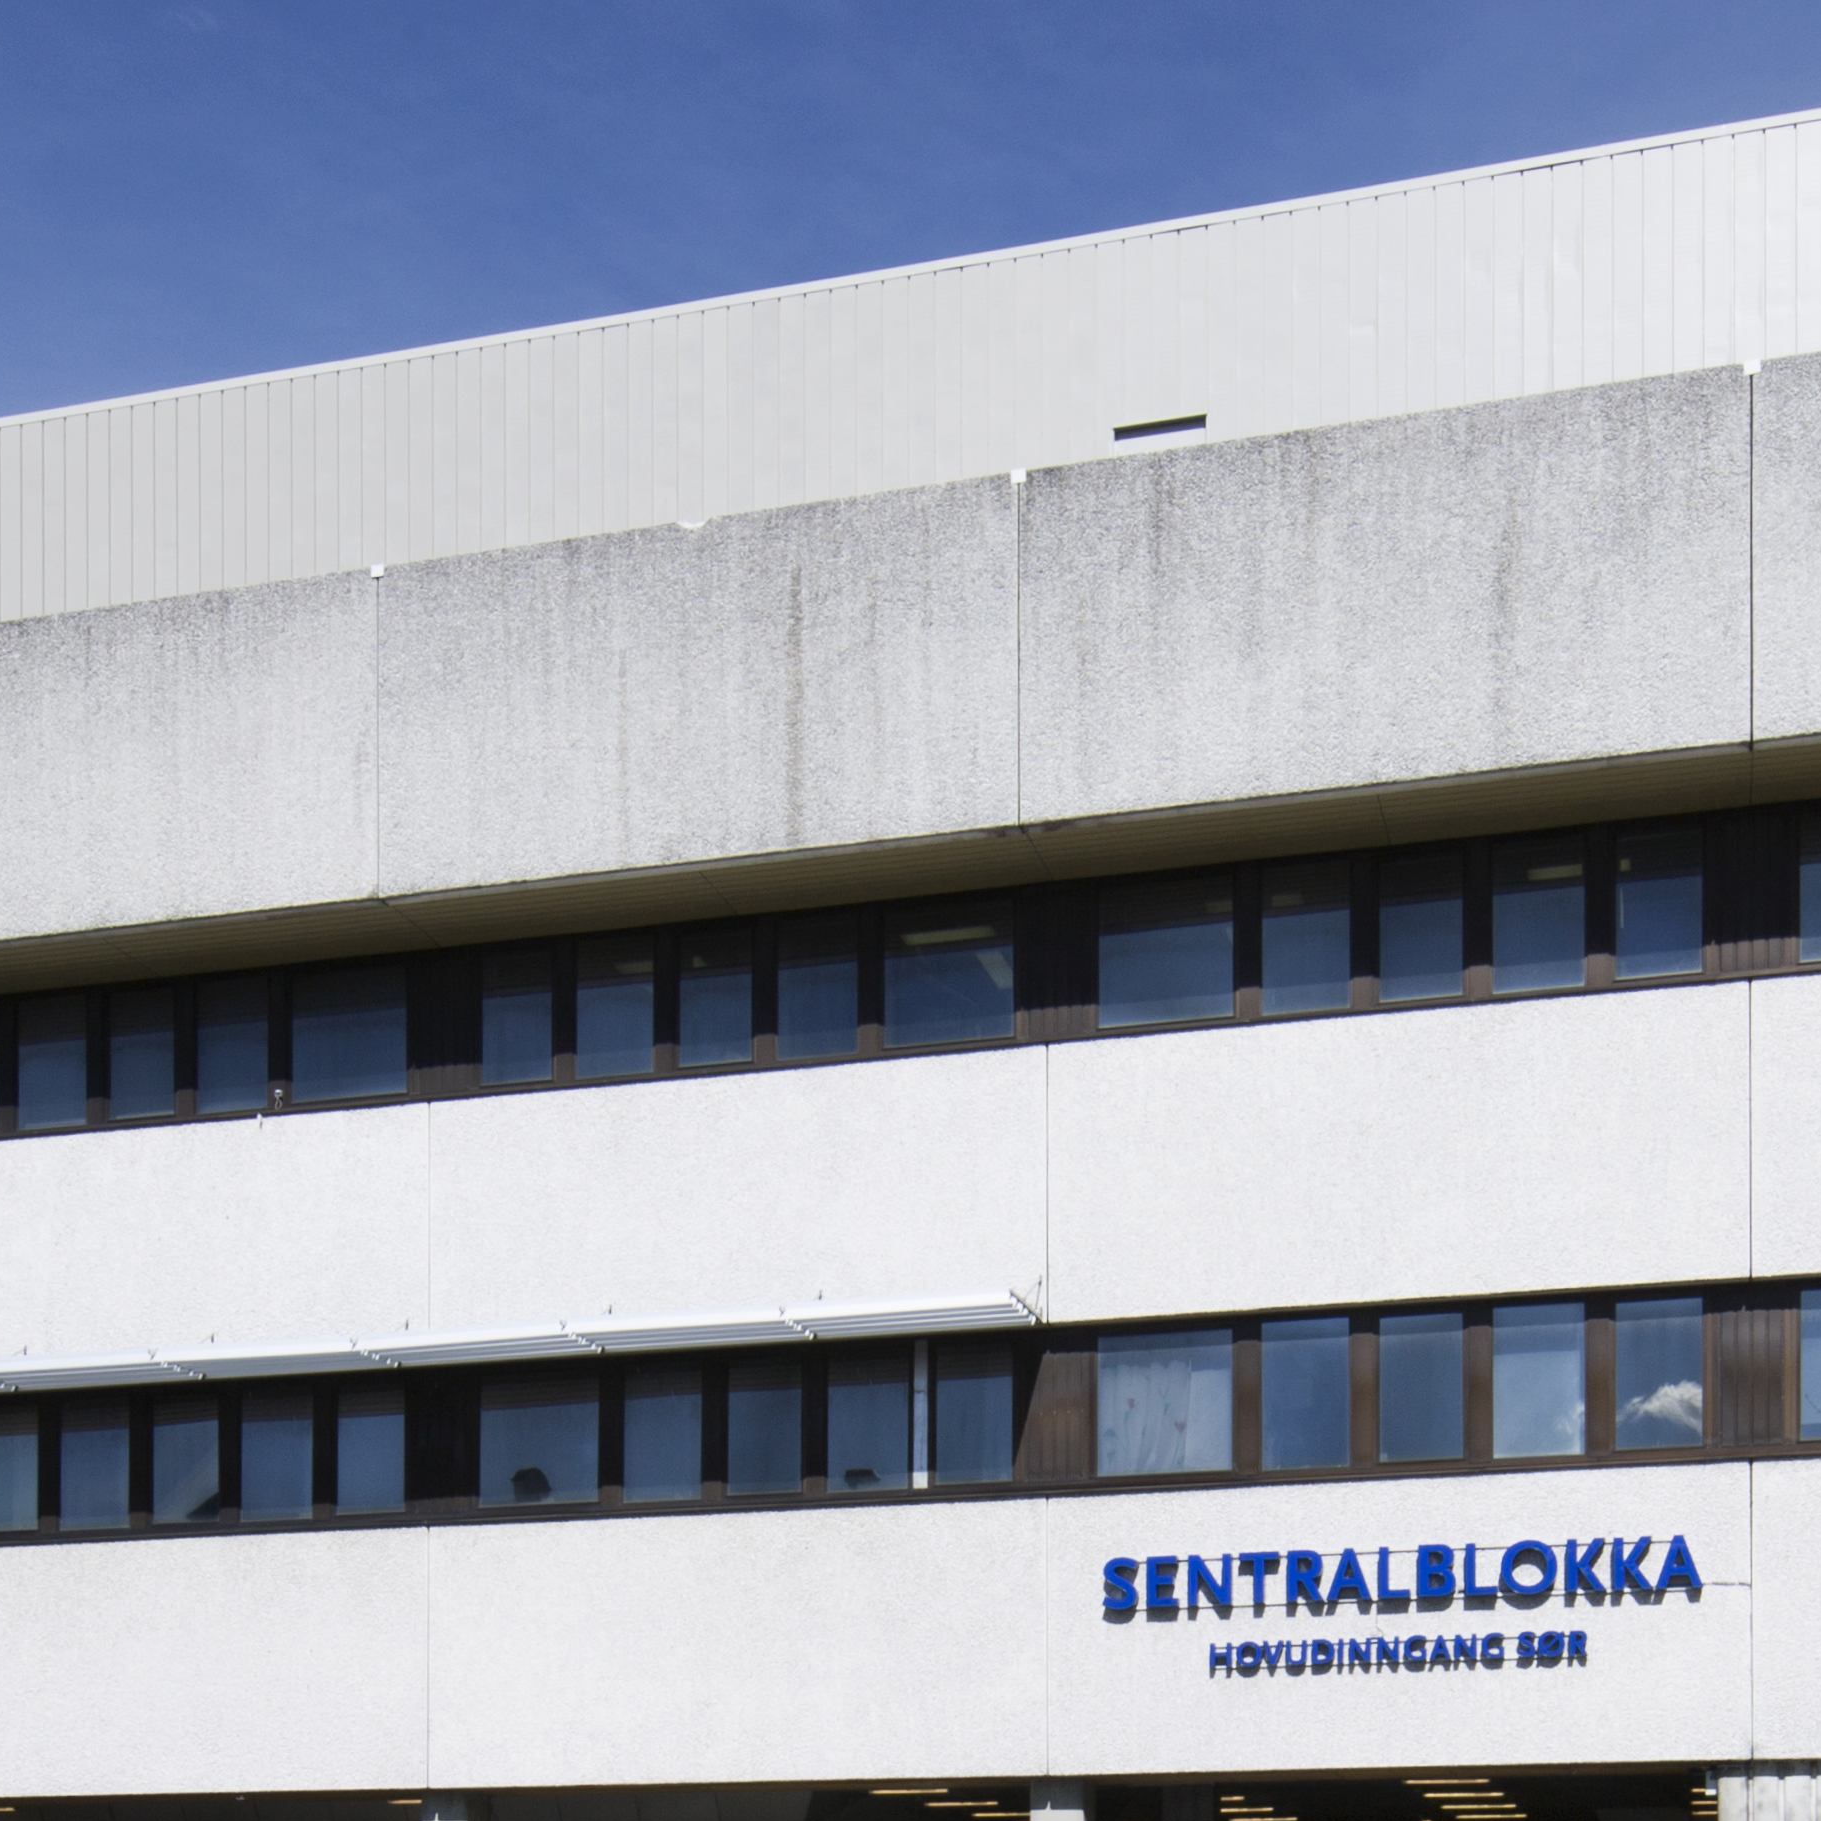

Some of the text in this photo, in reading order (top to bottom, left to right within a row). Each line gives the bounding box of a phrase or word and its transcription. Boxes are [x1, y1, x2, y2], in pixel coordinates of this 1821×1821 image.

[1102, 1535, 1702, 1610] SENTRALBLOKKA
[1209, 1631, 1587, 1669] HOVUDINNGANG SØR
